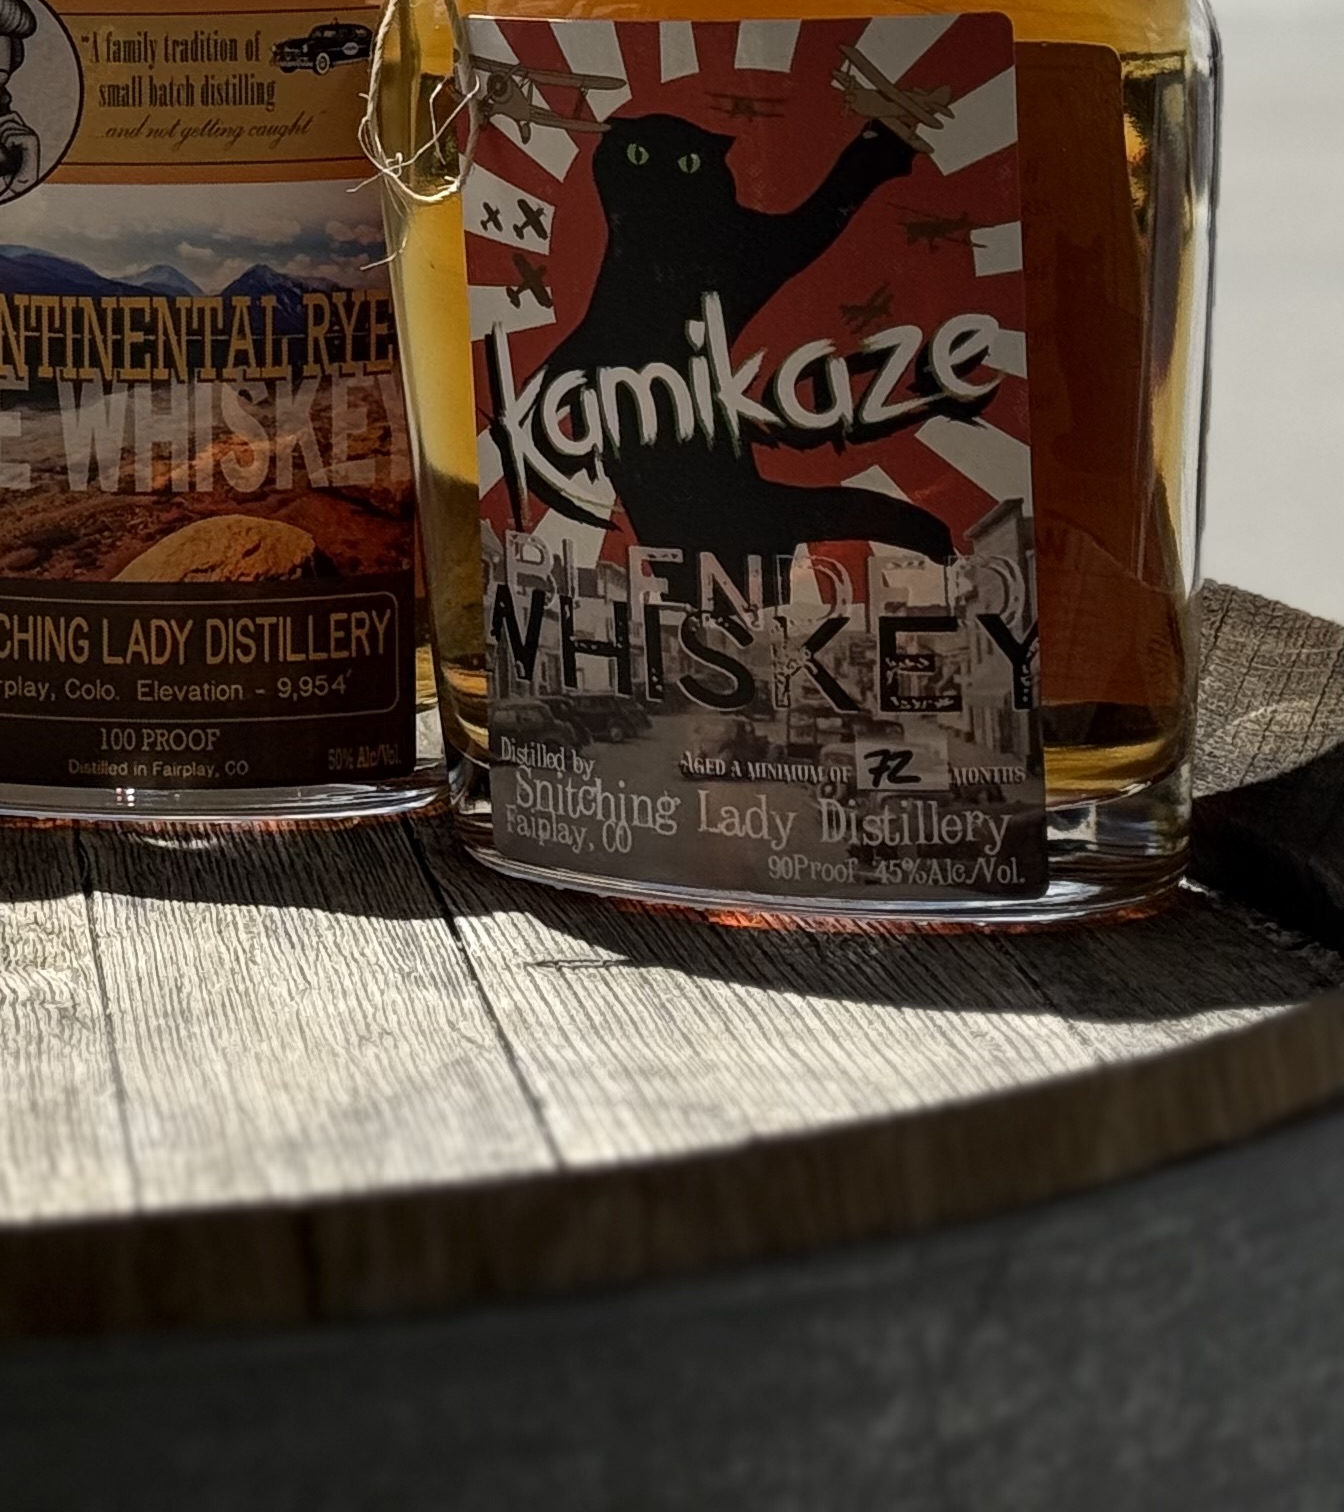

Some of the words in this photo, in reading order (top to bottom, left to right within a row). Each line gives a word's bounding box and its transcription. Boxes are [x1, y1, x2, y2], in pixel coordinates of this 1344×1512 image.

[105, 30, 158, 71] family
[163, 28, 239, 64] tradition
[245, 28, 262, 63] of
[98, 74, 145, 108] small
[148, 73, 195, 108] batch
[200, 72, 279, 113] distilling
[173, 117, 246, 150] getting
[300, 288, 395, 377] RYE
[101, 616, 193, 666] LADY
[204, 607, 392, 665] DISTILLERY
[490, 584, 1039, 714] WHISKEY
[64, 678, 121, 701] Colo.
[136, 679, 244, 703] Elevation
[98, 727, 137, 752] 100
[141, 728, 221, 753] PROOF
[499, 734, 566, 773] Distilled
[571, 748, 596, 781] by
[67, 758, 129, 777] Distilled
[133, 759, 148, 777] in
[151, 759, 220, 781] Fairplay,
[223, 759, 249, 776] CO
[679, 750, 726, 777] AGED
[746, 760, 824, 784] MINIMUM
[828, 765, 853, 783] OF
[515, 764, 682, 837] Snitching
[696, 789, 798, 851] Lady
[815, 796, 1014, 856] Distillery
[601, 819, 633, 854] CO
